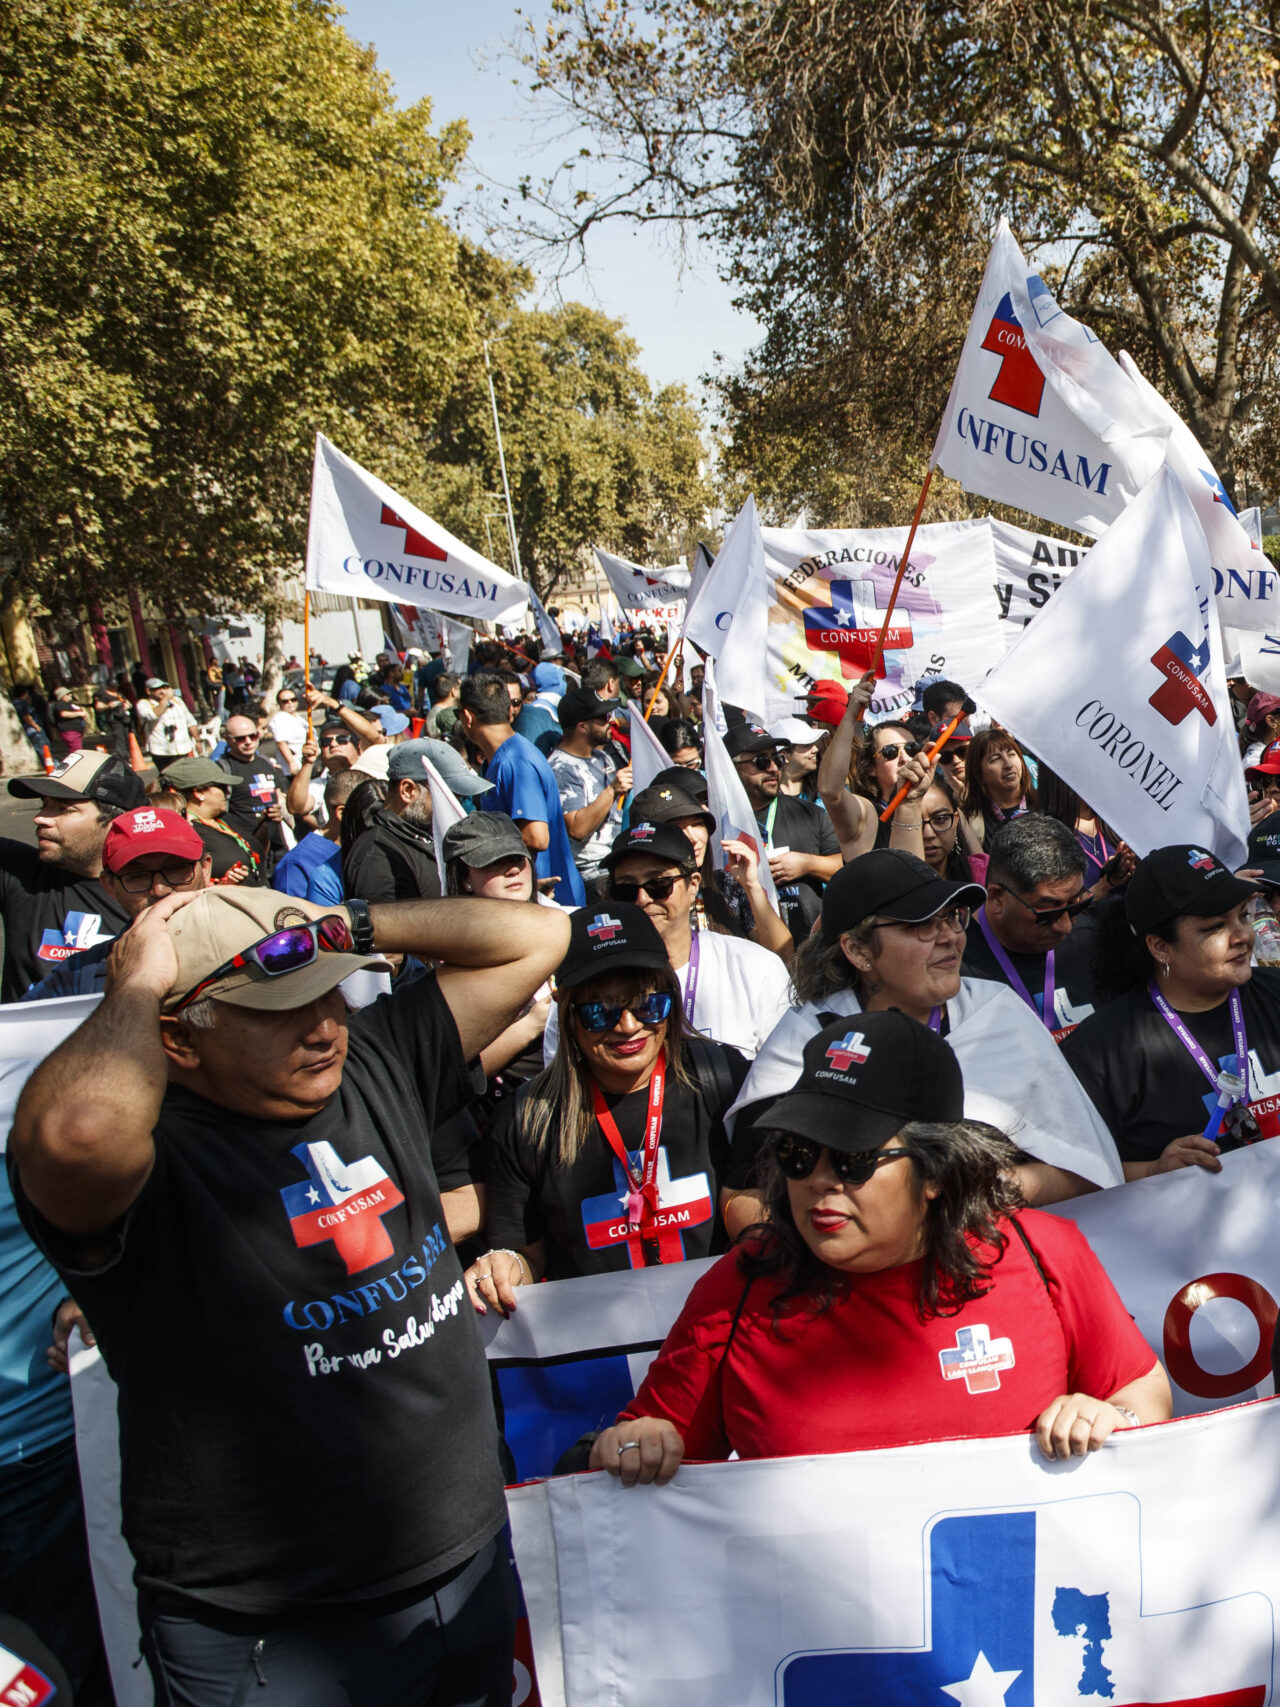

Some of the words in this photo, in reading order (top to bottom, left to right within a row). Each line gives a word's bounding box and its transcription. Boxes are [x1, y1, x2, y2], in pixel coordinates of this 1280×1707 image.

[343, 556, 499, 602] CONFUSAM
[783, 548, 926, 594] FEDERACIONES
[820, 629, 901, 644] CONFUSM
[1166, 661, 1209, 709] CONFUSAM
[1075, 699, 1184, 811] CORONEL
[593, 938, 627, 951] CONFUSAM
[1177, 1025, 1197, 1050] CONFUSAM
[653, 1075, 661, 1106] CONFUSAM
[815, 1070, 857, 1085] CONFUSAM
[649, 1116, 657, 1149] CONFUSAM
[317, 1190, 386, 1228] CONFUSAM
[283, 1223, 448, 1331] CONFUSAM
[304, 1342, 343, 1376] Por
